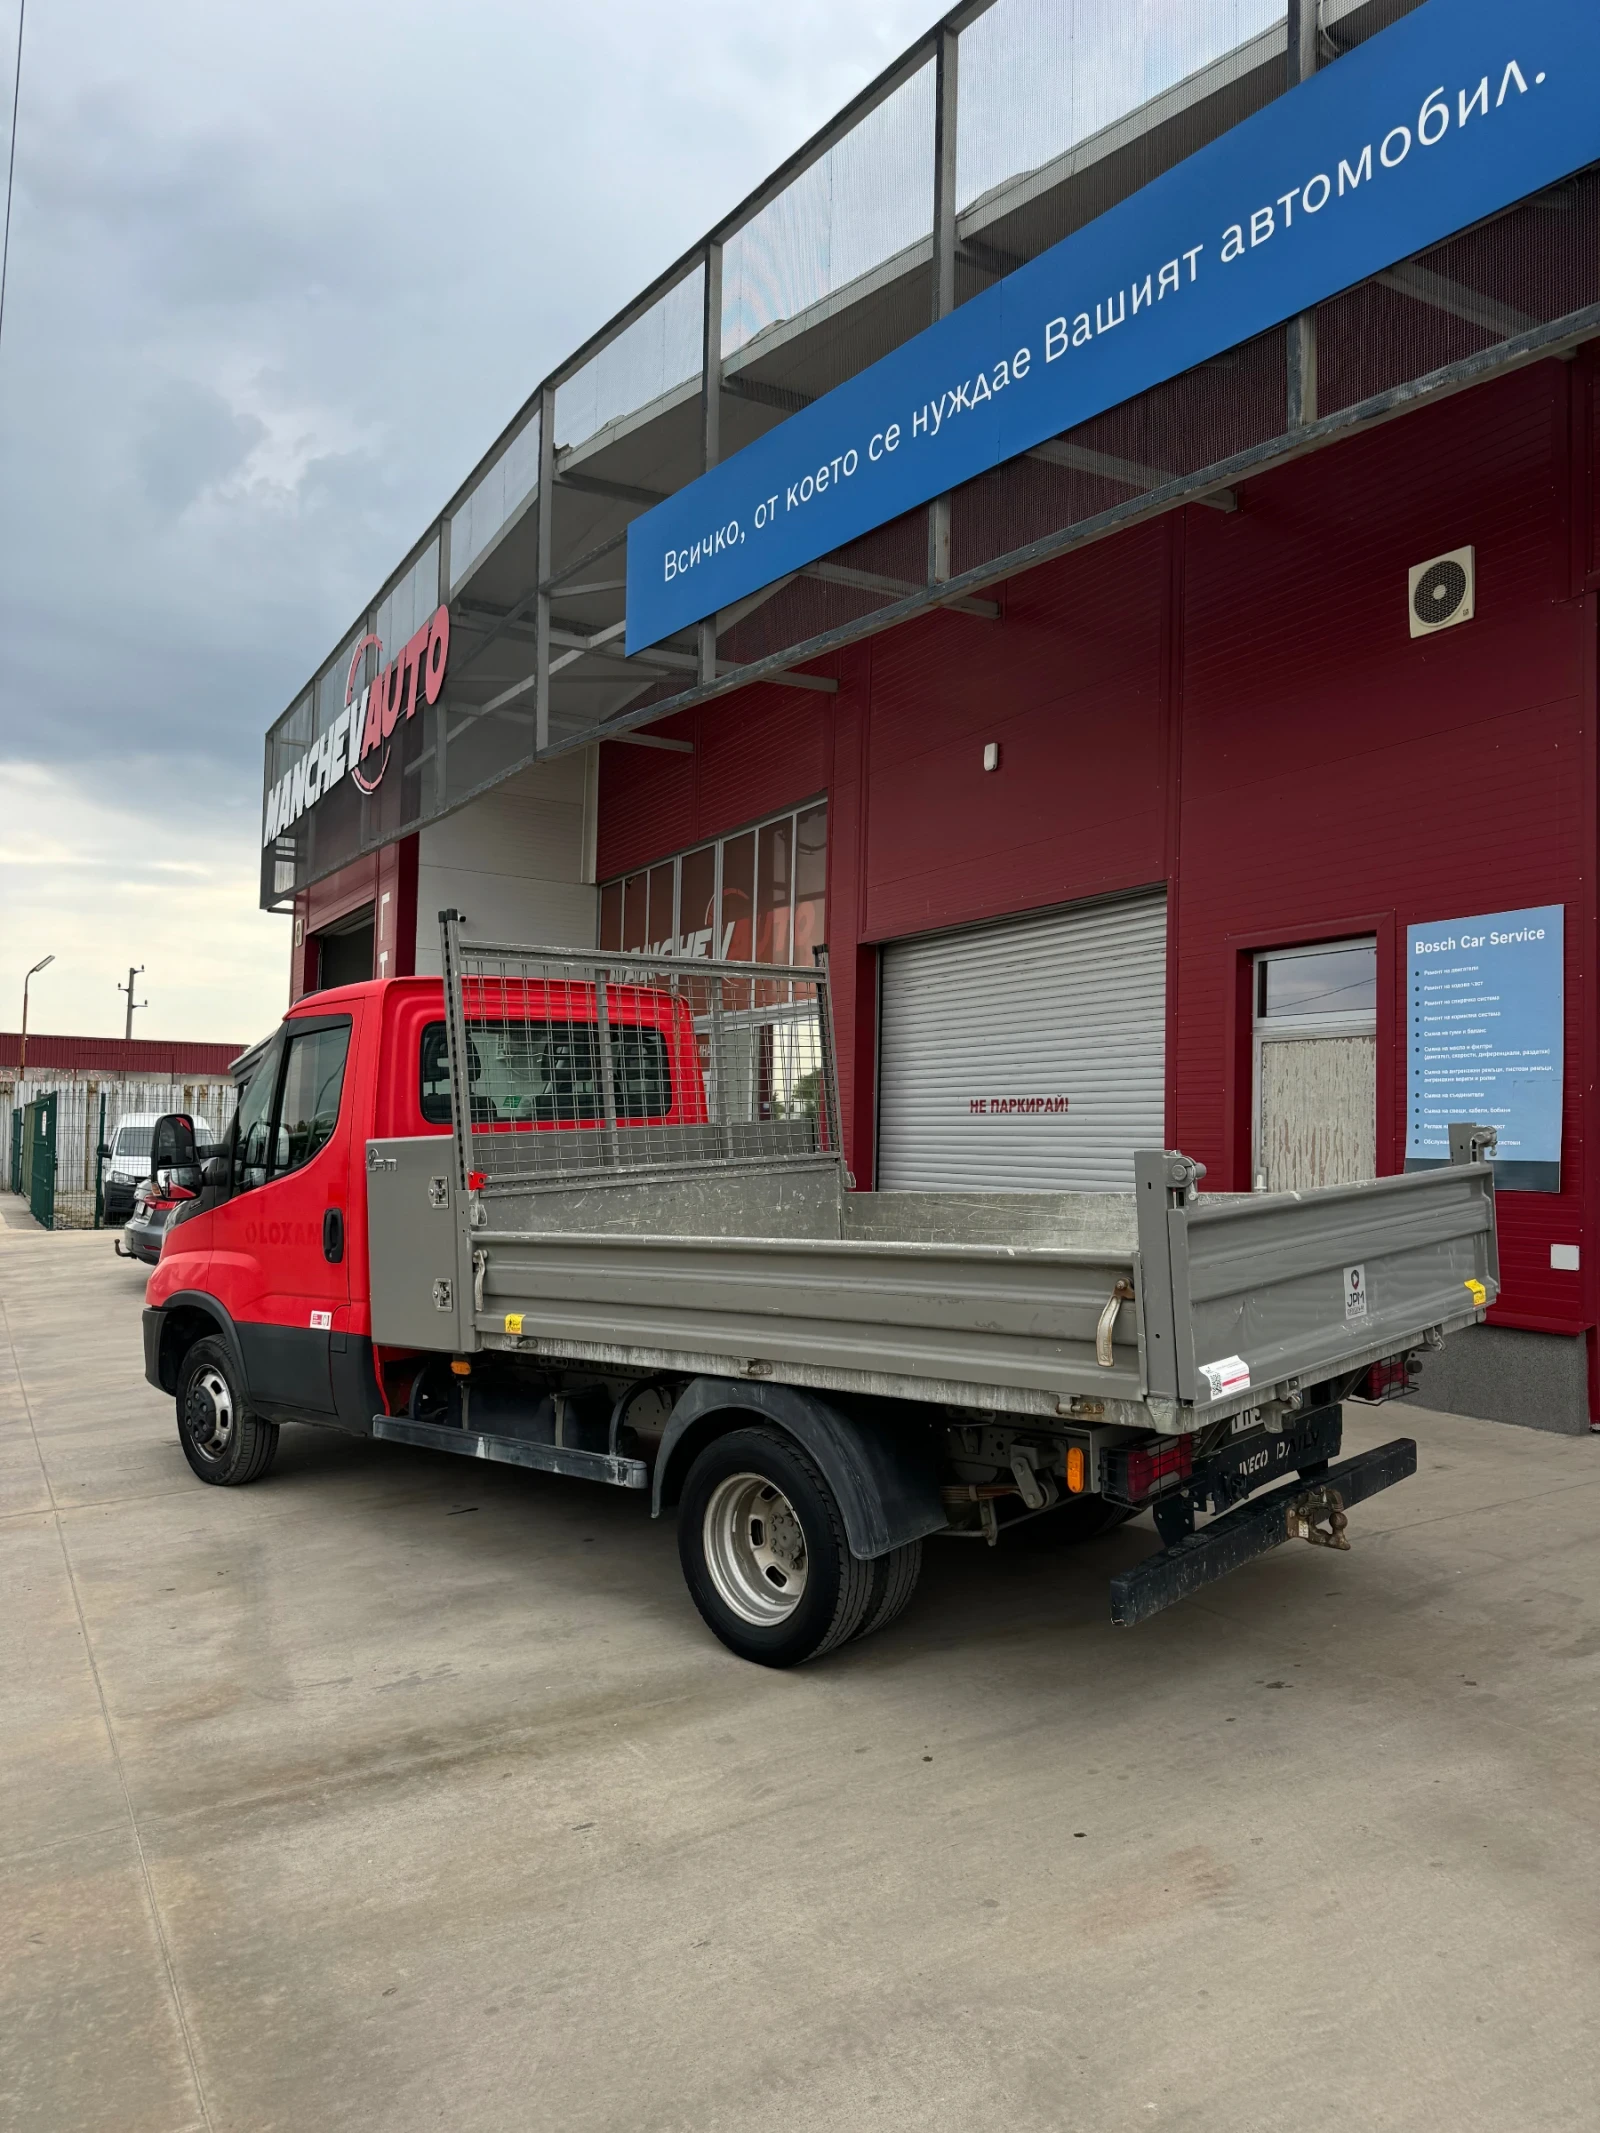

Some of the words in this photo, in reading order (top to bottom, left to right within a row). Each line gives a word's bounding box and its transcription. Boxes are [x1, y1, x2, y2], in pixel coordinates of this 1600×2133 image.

[664, 520, 746, 582] Всичко,
[754, 495, 779, 529] от
[785, 449, 858, 512] което
[868, 423, 900, 461] се
[912, 347, 1031, 438] нуждае
[1044, 244, 1204, 363] Вашият
[1220, 60, 1547, 263] автомобил.
[1415, 937, 1456, 954] Bosch
[1460, 935, 1485, 949] Car
[1489, 927, 1546, 945] Service
[970, 1099, 987, 1113] НЕ
[990, 1094, 1069, 1113] ПАРКИРАЙ!
[1346, 1290, 1365, 1307] JPM
[1239, 1449, 1269, 1476] IVECO
[1276, 1427, 1320, 1460] DAILY
